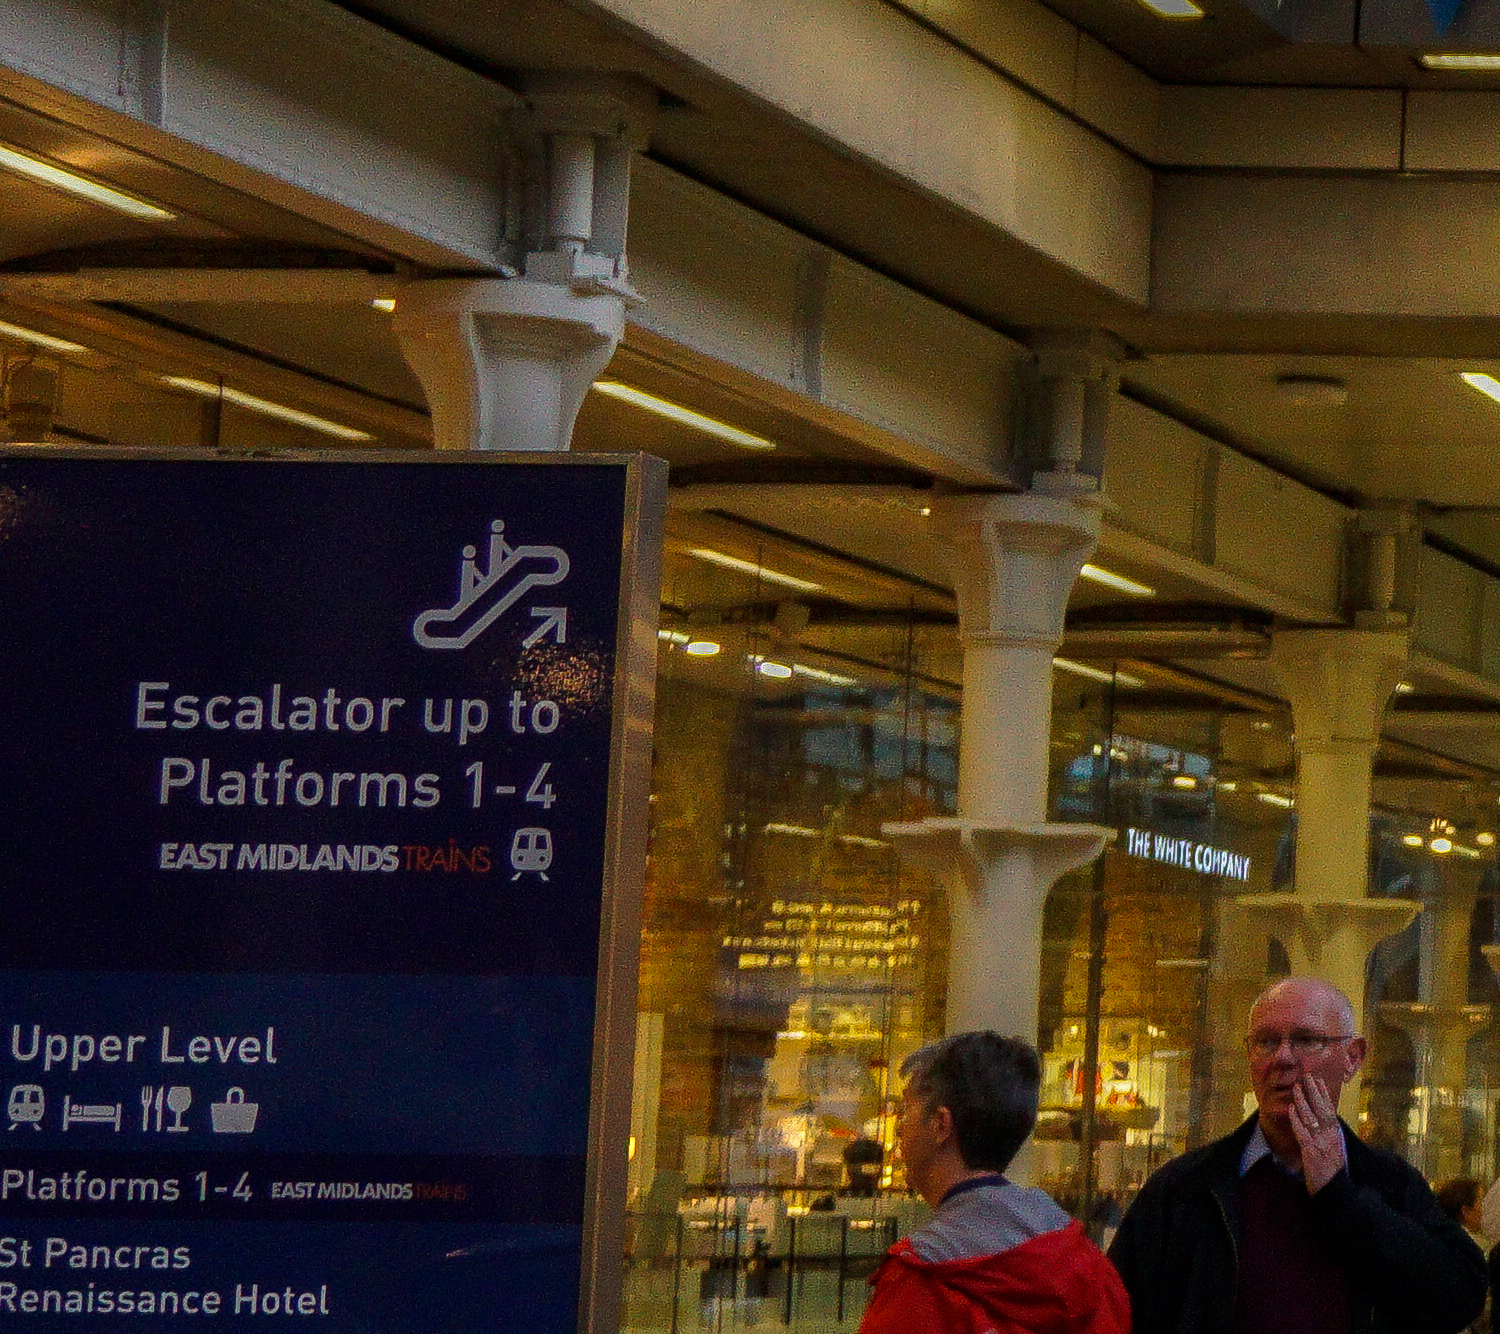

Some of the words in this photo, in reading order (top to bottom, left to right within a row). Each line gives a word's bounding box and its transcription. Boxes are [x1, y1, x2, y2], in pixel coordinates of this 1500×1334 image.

[135, 682, 404, 732] Escalator
[425, 698, 488, 744] up
[509, 689, 560, 734] to
[160, 757, 440, 807] Platforms
[465, 762, 556, 809] 1-4
[159, 843, 233, 870] EAST
[238, 843, 398, 872] MIDLANDS
[1127, 828, 1151, 858] THE
[1154, 834, 1192, 869] WHITE
[1195, 844, 1250, 881] COMPANY
[12, 1025, 146, 1071] Upper
[161, 1027, 276, 1063] Level
[2, 1169, 179, 1201] Platforms
[195, 1172, 252, 1201] 1-4
[271, 1181, 315, 1199] EAST
[317, 1182, 413, 1200] MIDLANDS
[44, 1237, 190, 1269] Pancras
[0, 1282, 222, 1314] Renaissance
[235, 1284, 329, 1315] Hotel
